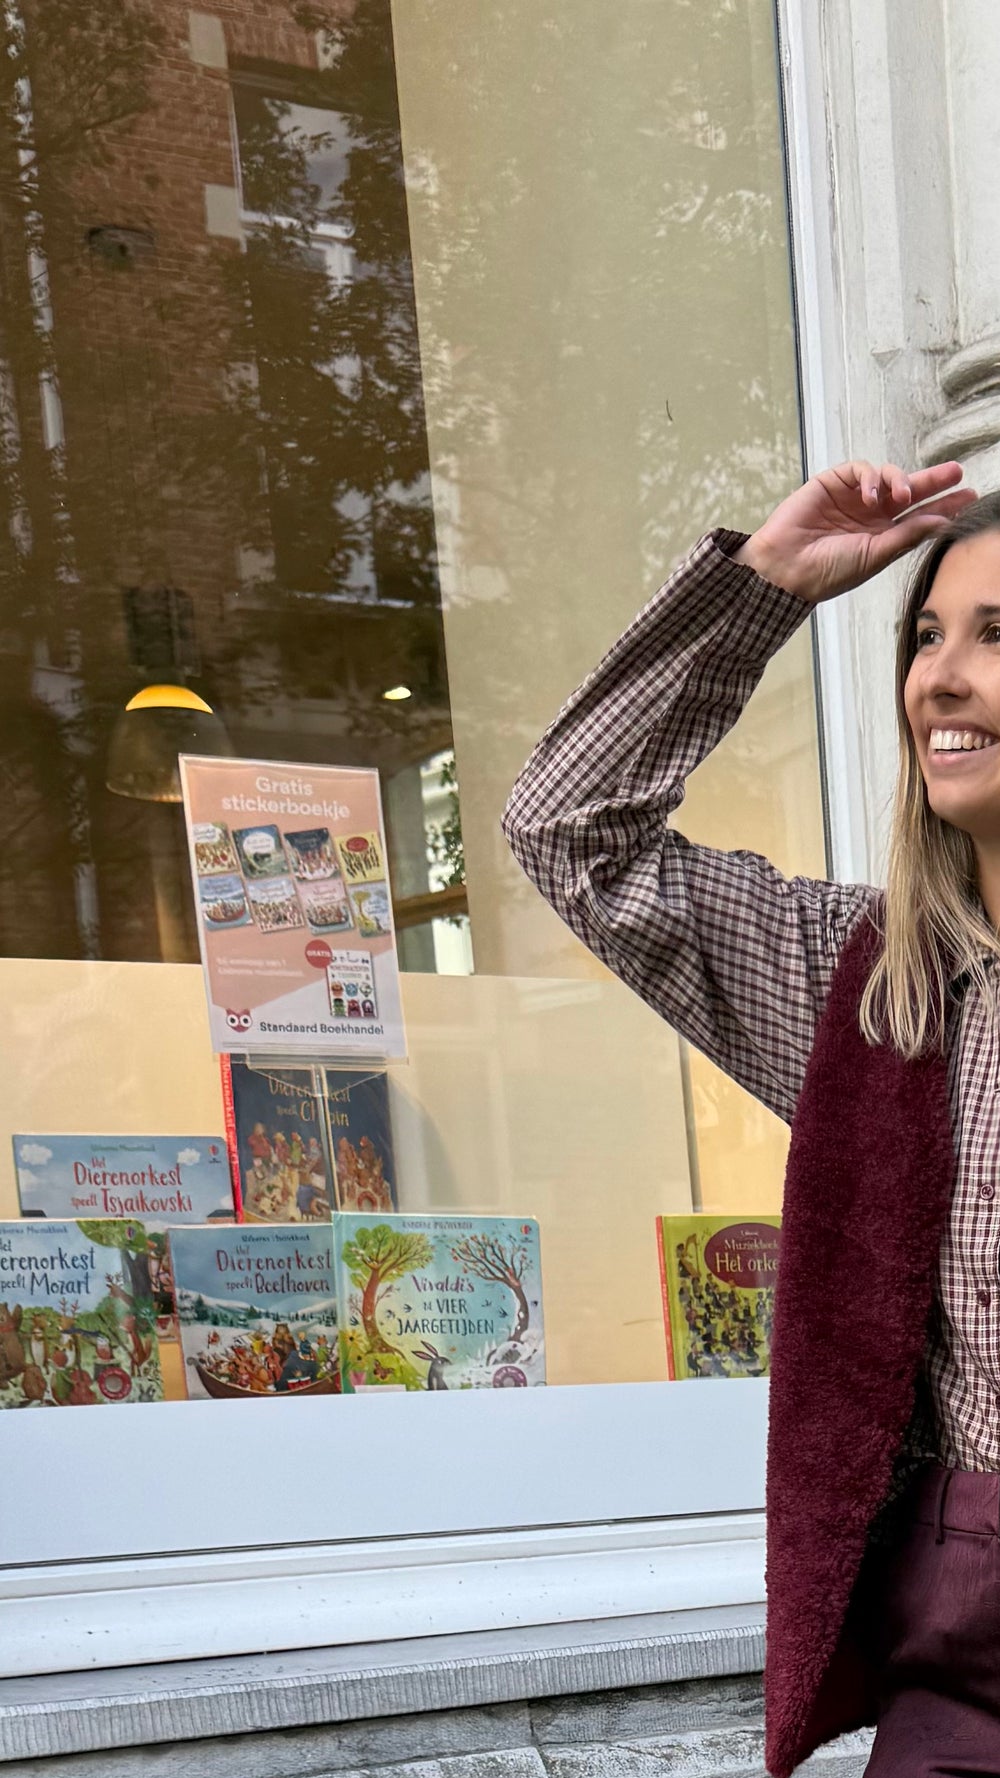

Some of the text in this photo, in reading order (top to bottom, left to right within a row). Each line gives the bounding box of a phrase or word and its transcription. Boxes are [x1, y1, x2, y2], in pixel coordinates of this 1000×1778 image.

[255, 776, 313, 796] Gratis
[221, 793, 350, 820] stickerboekje
[259, 1021, 384, 1036] Standaard Boekhandel
[73, 1161, 182, 1186] Dierenorkest
[71, 1188, 192, 1217] speelt Tsjaikovski
[0, 1247, 96, 1271] erenorkest
[216, 1248, 332, 1272] Dierenorkest
[716, 1251, 778, 1273] Het orke
[0, 1272, 91, 1296] peelt Mozart
[226, 1272, 330, 1294] speelt Beethoven
[411, 1275, 475, 1293] Vivaldi's
[436, 1298, 468, 1315] VIER
[397, 1319, 494, 1336] JAARGETIJDEN
